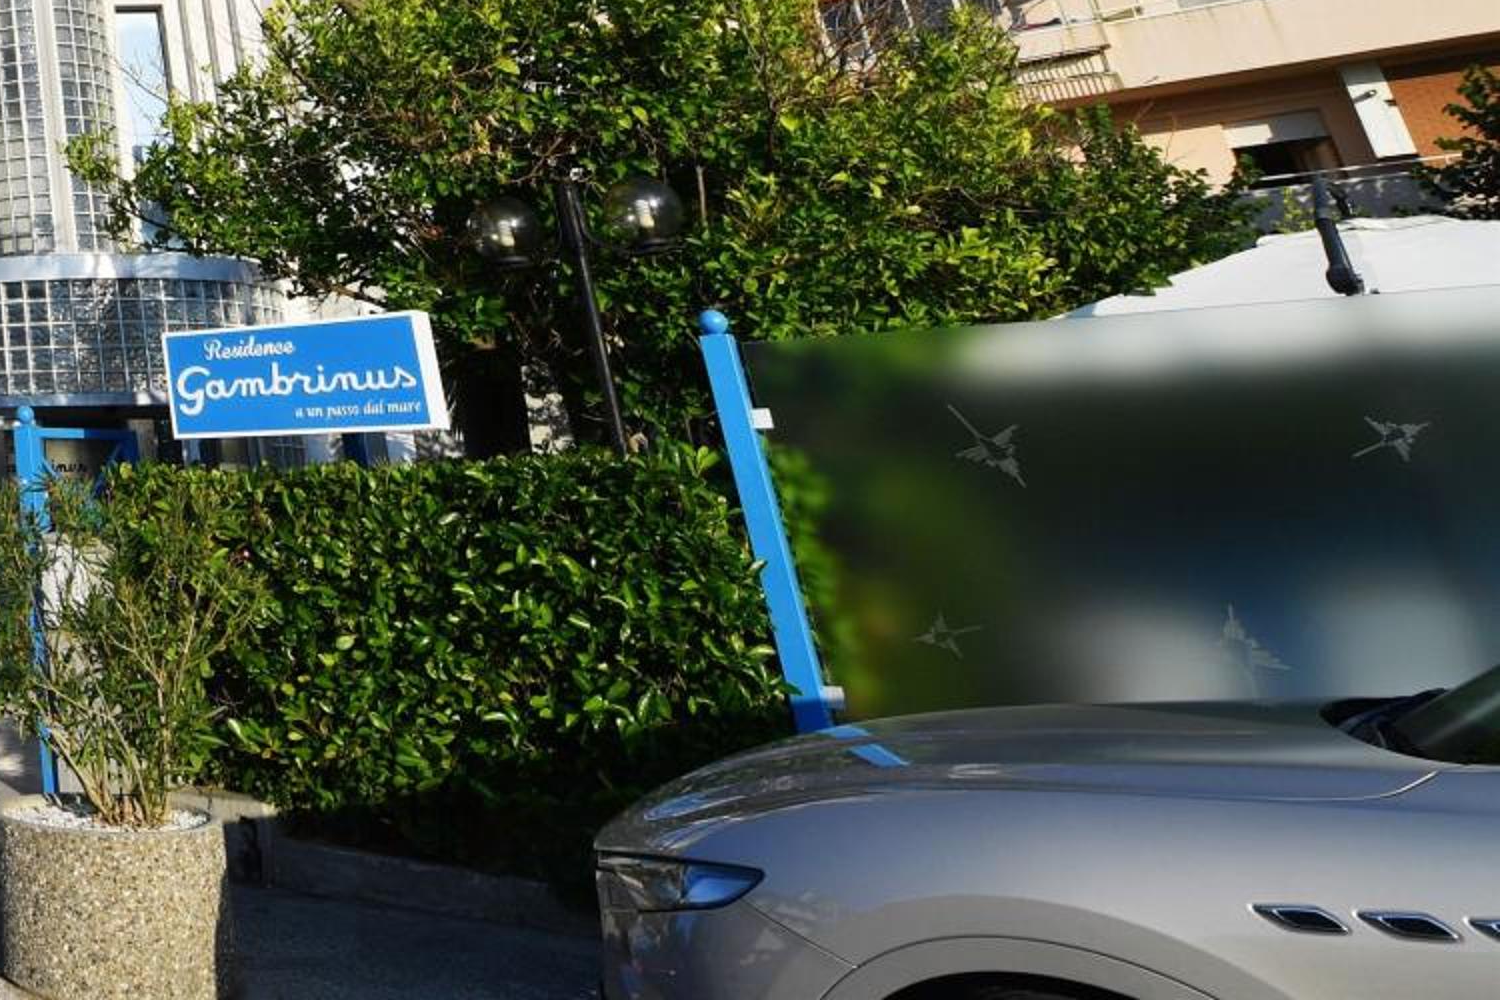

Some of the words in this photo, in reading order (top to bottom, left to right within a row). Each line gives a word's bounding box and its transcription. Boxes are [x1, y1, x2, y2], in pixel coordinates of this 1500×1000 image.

[203, 334, 296, 361] Residence
[176, 362, 417, 416] Gambrinus
[295, 407, 304, 417] a
[306, 407, 324, 417] un
[387, 400, 421, 414] mare
